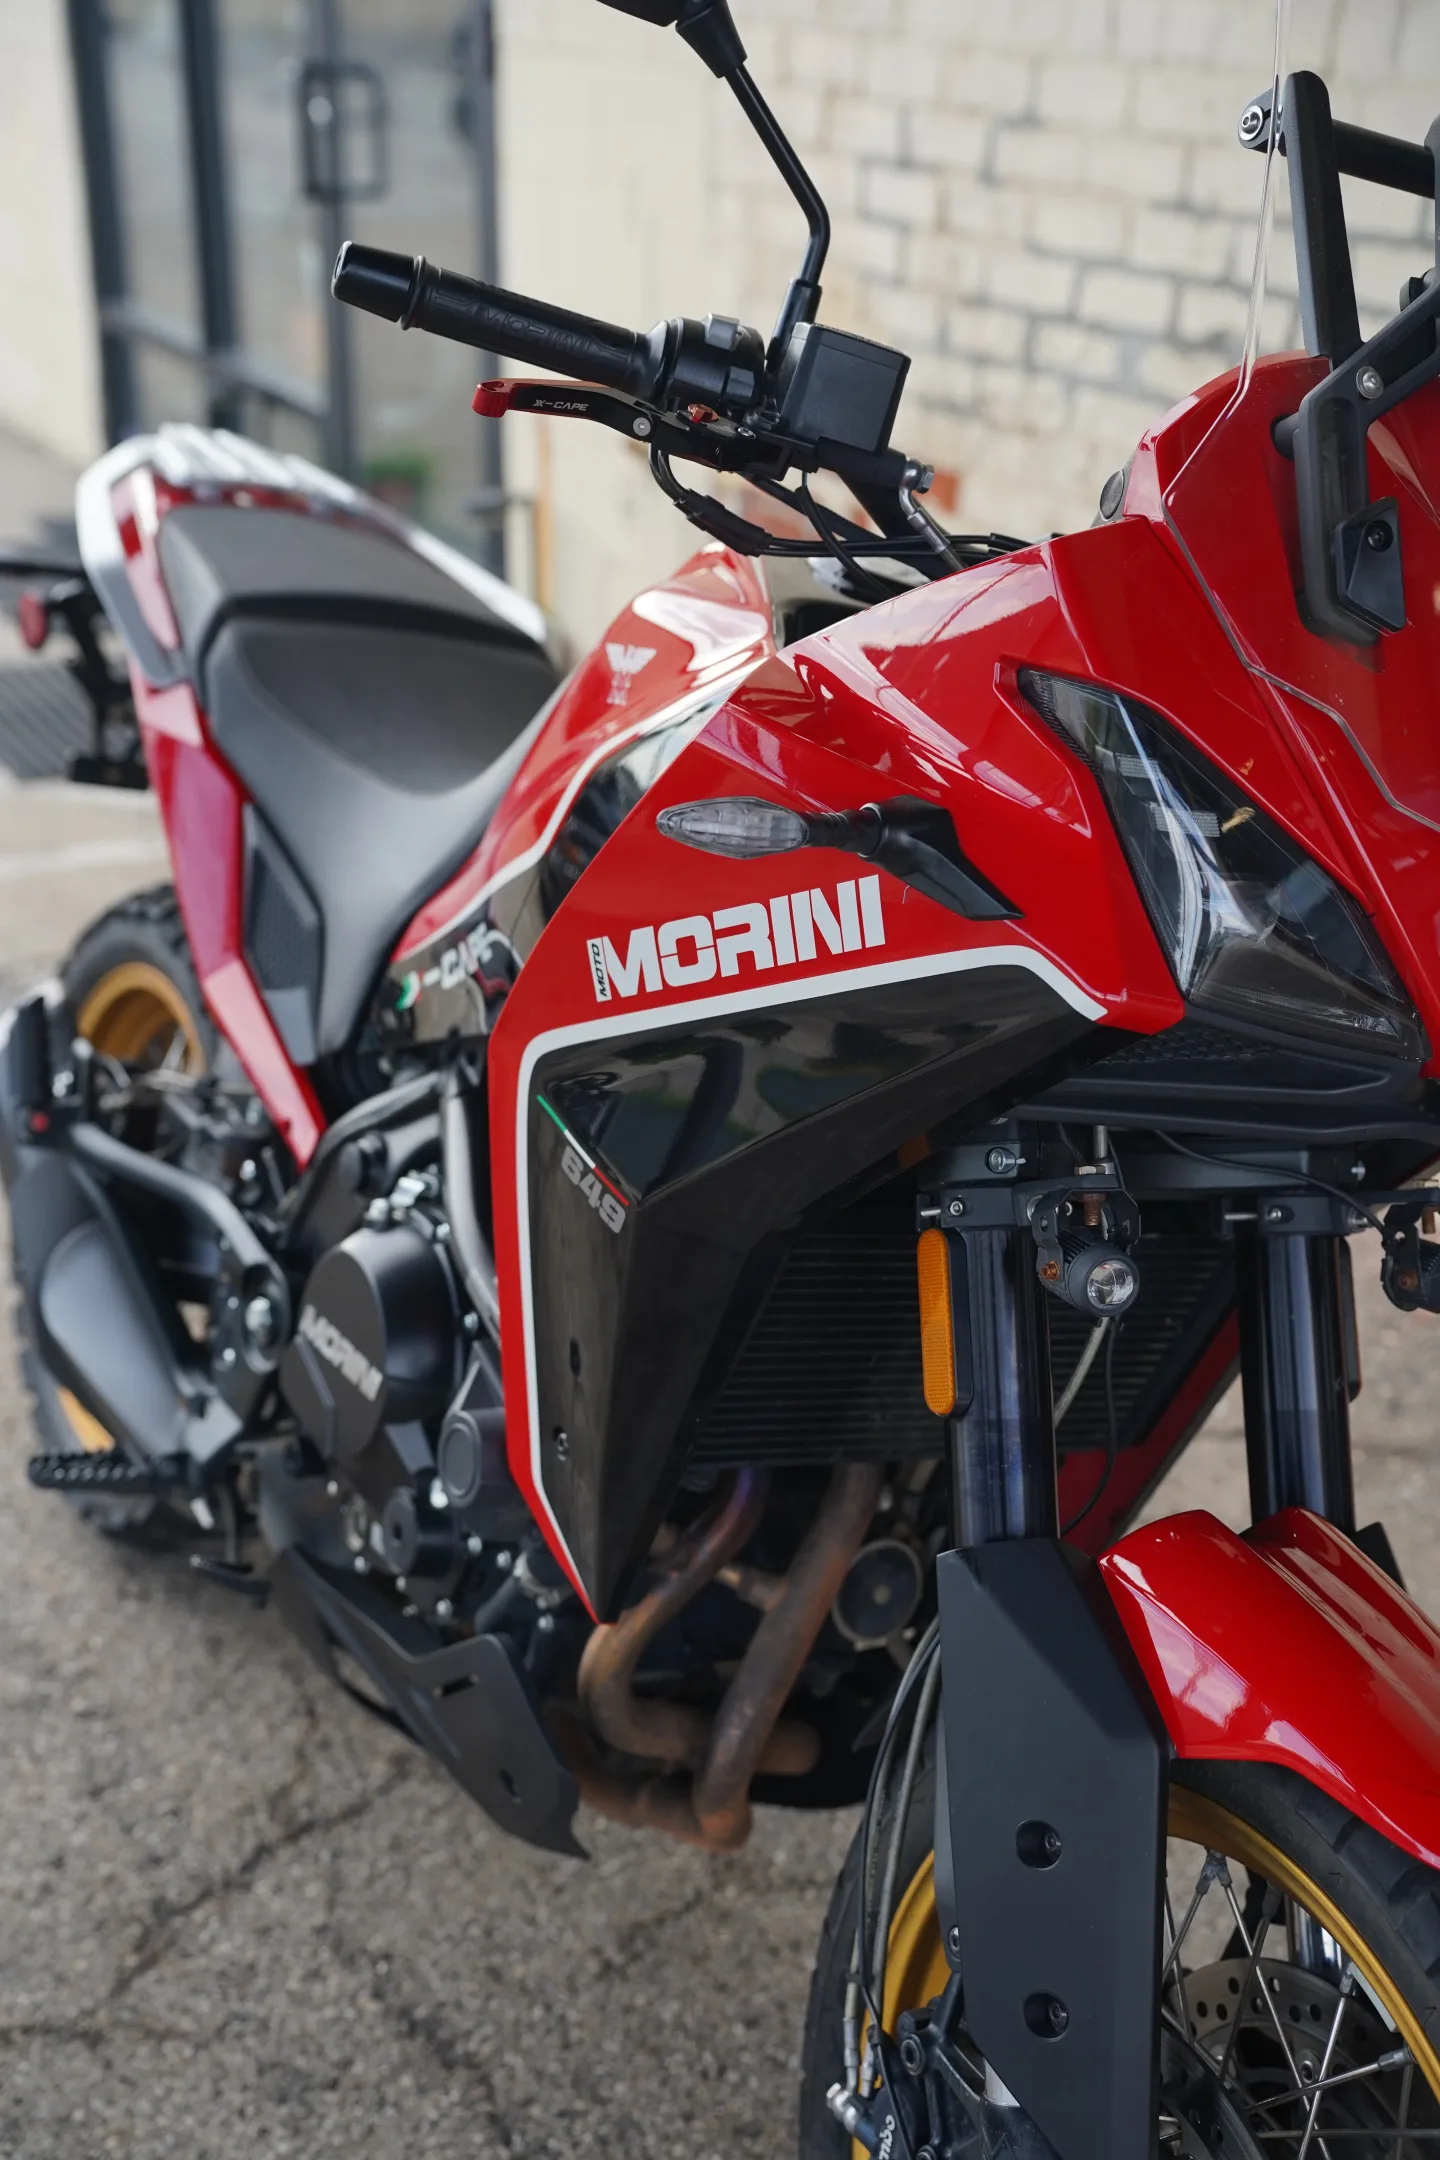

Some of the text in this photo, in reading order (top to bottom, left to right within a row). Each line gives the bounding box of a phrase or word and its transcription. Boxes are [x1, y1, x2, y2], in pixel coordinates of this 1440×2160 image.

[532, 399, 590, 411] X-CAPE
[591, 943, 607, 997] MOTO
[602, 874, 886, 998] MORINI
[561, 1145, 626, 1234] 649
[298, 1304, 383, 1402] MORINI
